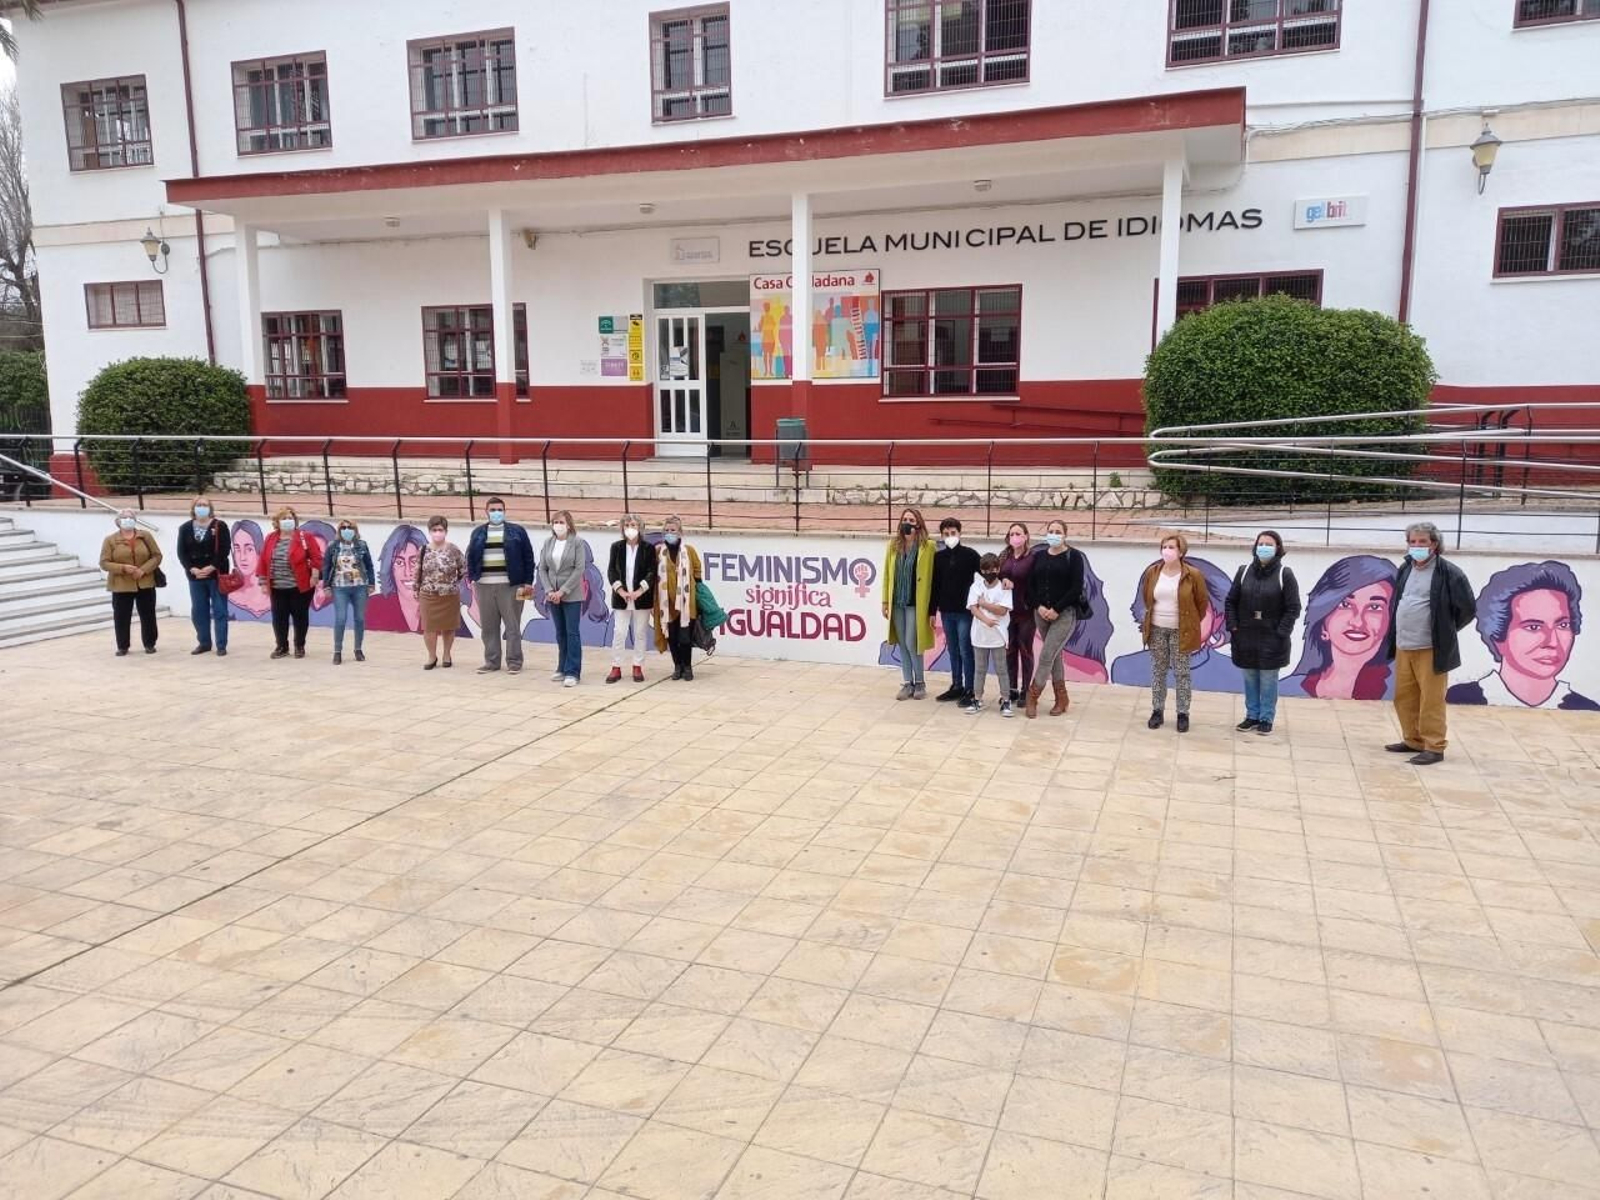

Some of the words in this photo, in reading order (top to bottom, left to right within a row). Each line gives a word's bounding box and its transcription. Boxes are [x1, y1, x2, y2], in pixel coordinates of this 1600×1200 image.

[885, 224, 1055, 252] MUNICIPAL
[1064, 219, 1108, 241] DE
[1117, 208, 1263, 238] IDIMAS
[753, 276, 783, 290] Casa
[786, 273, 856, 289] Cadana
[703, 552, 877, 587] FEMINISMO
[745, 581, 832, 611] significa
